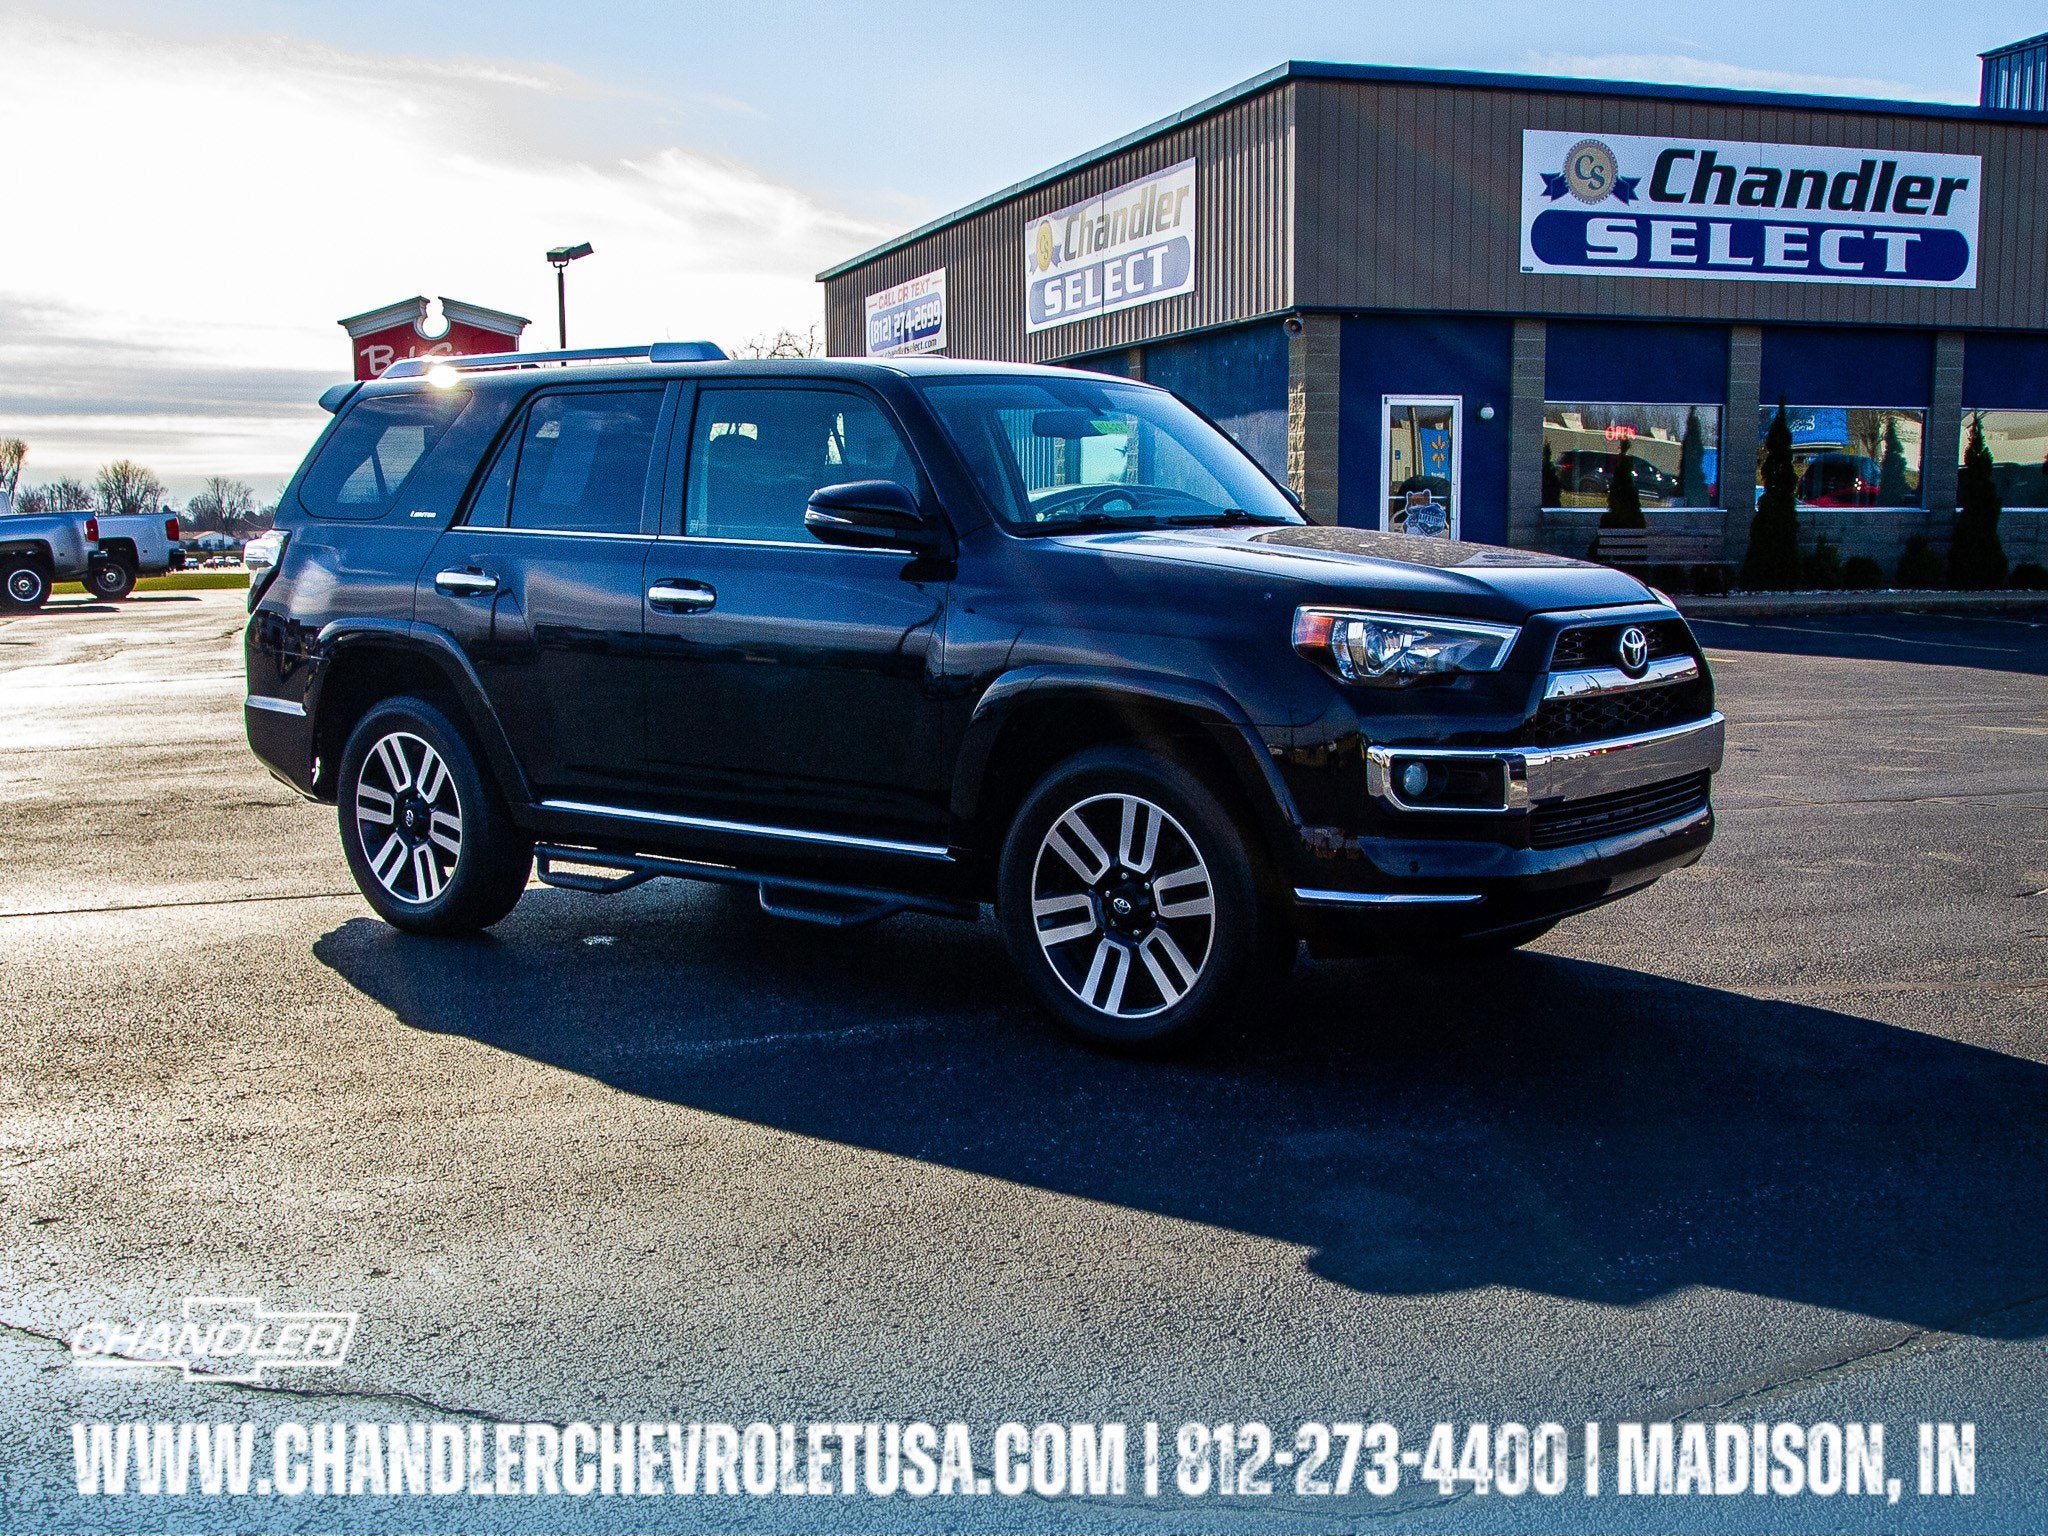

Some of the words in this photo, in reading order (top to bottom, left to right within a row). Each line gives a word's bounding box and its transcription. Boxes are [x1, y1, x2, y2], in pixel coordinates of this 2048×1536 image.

[1648, 147, 1969, 217] Chandler
[1064, 183, 1190, 262] Chandler
[1586, 217, 1922, 273] SELECT
[879, 290, 896, 310] CALL
[898, 285, 909, 303] OR
[911, 278, 930, 298] TEXT
[1044, 244, 1169, 317] SELECT
[870, 314, 892, 347] (812)
[893, 299, 940, 338] 274-2699
